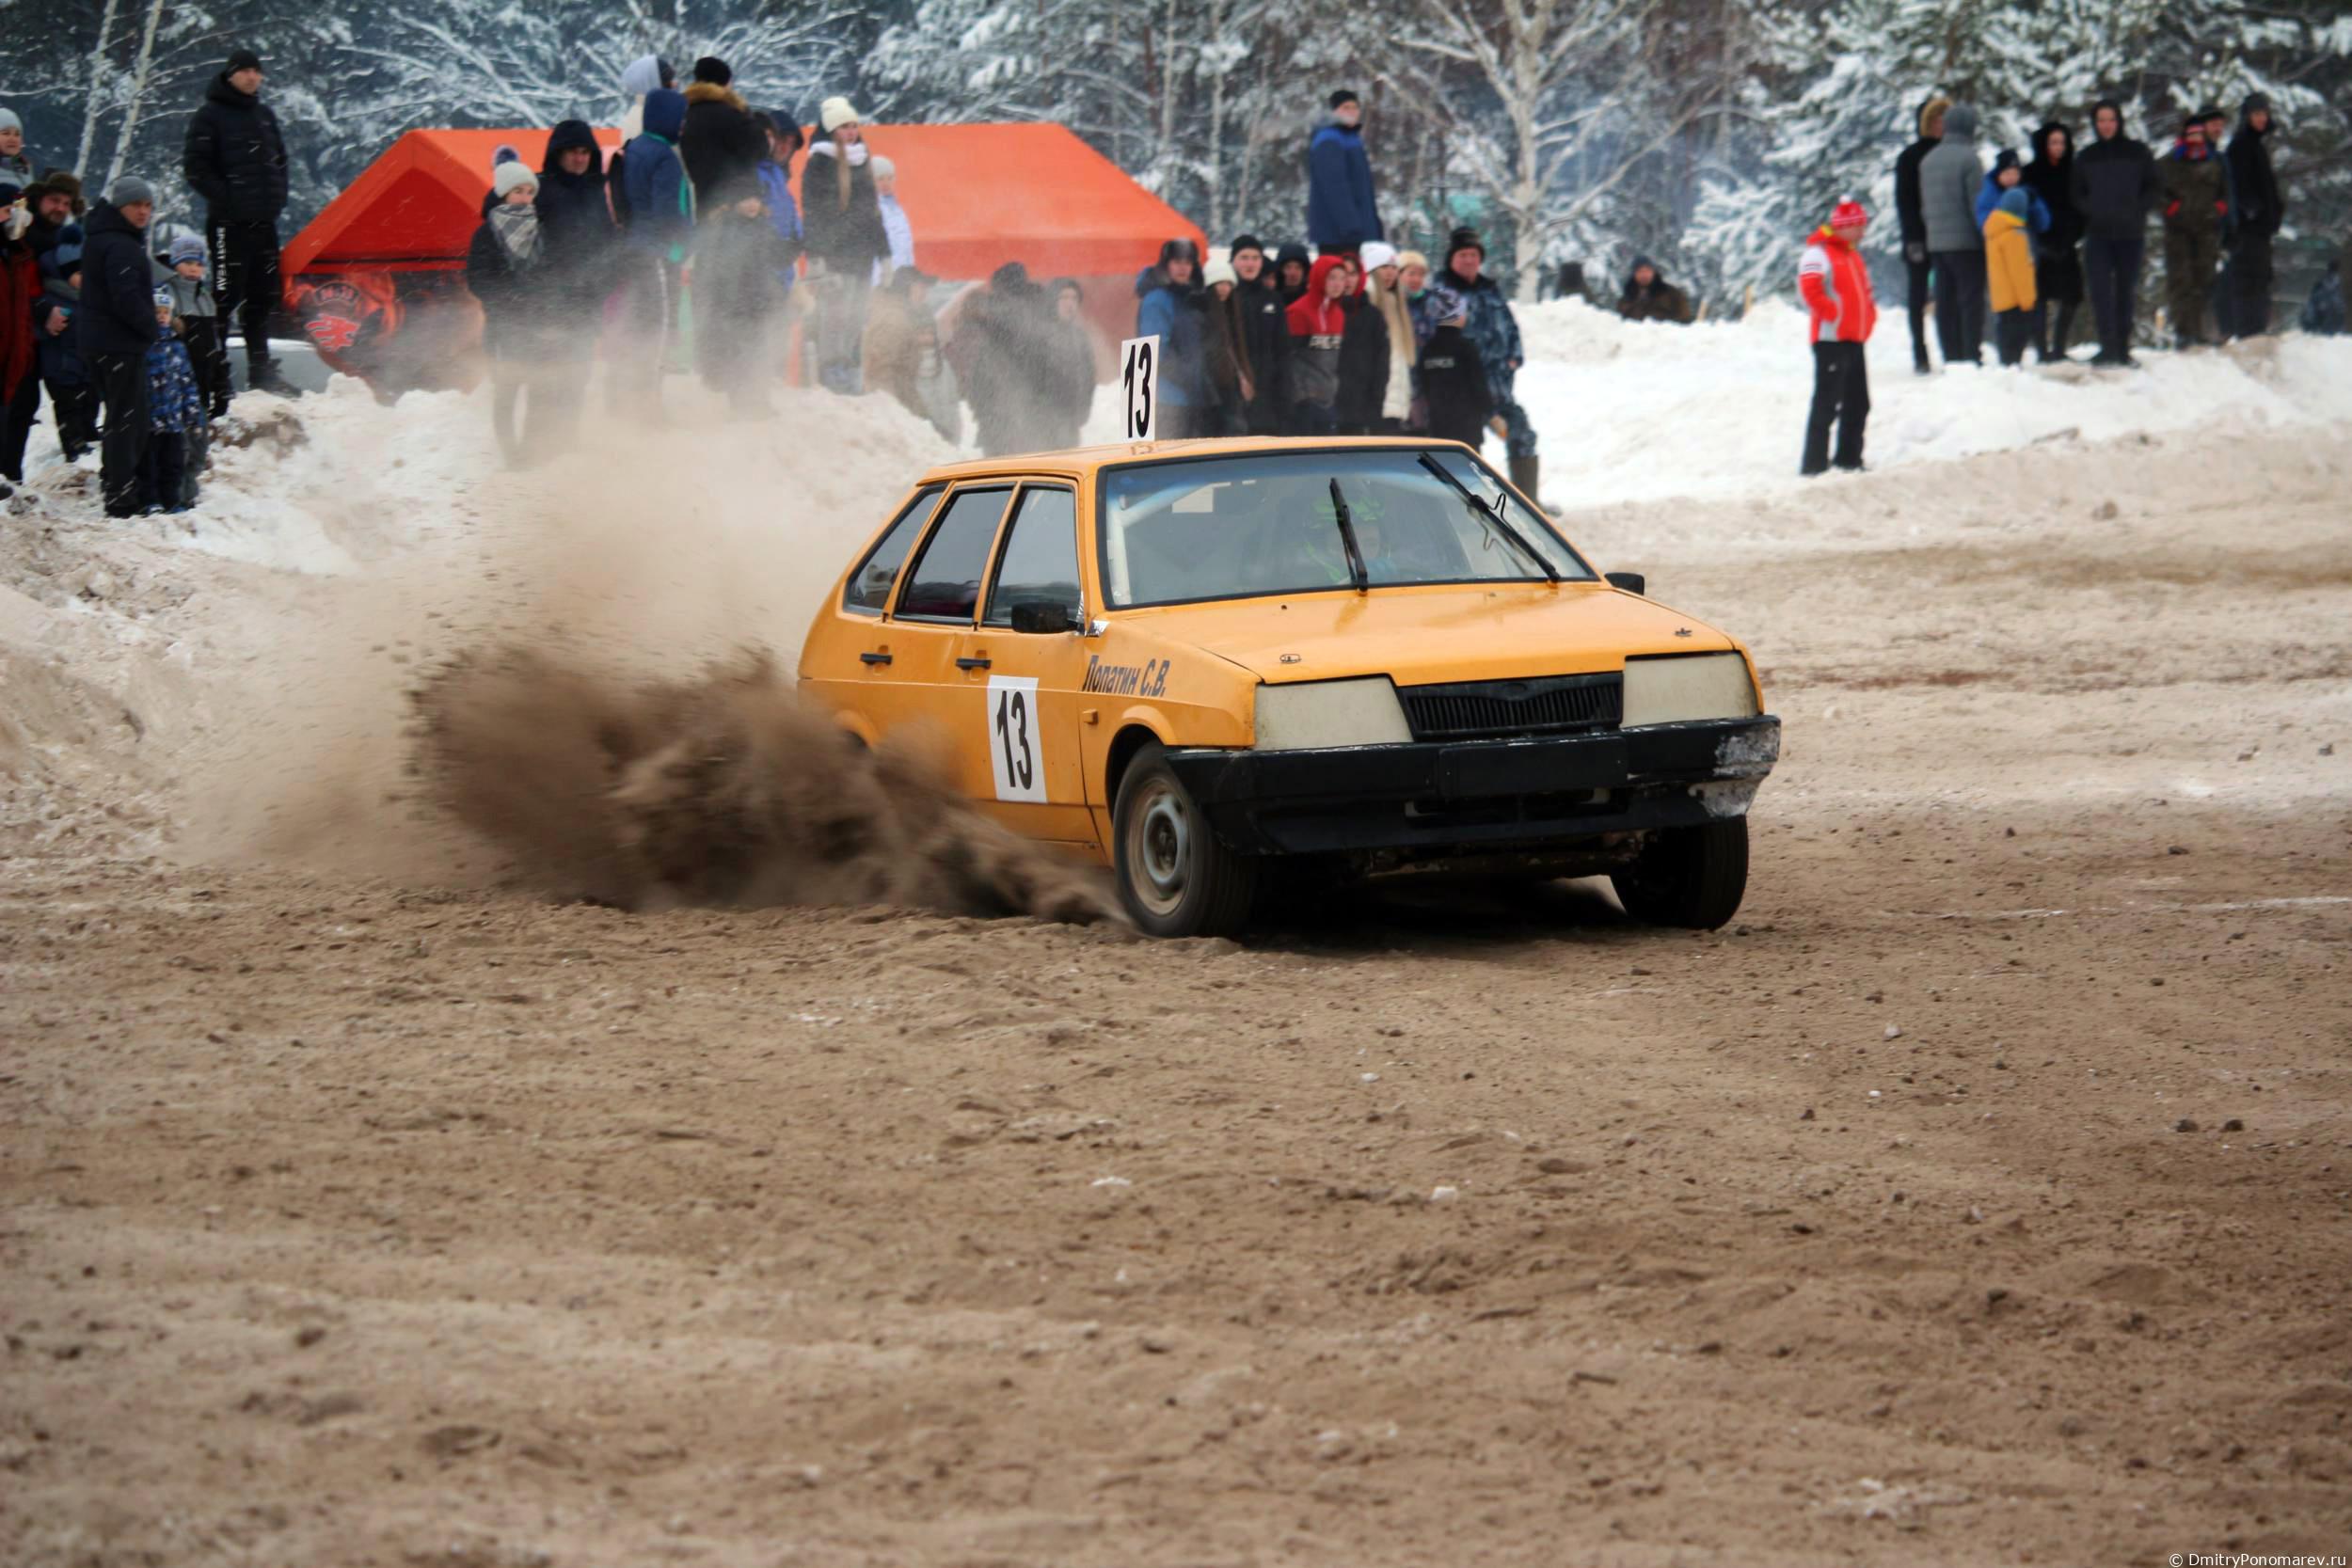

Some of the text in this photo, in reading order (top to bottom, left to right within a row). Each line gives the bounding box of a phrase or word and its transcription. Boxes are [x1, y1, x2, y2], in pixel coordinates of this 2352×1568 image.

[1124, 342, 1152, 438] 13
[1082, 655, 1141, 695] Лопатин
[997, 690, 1032, 790] 13
